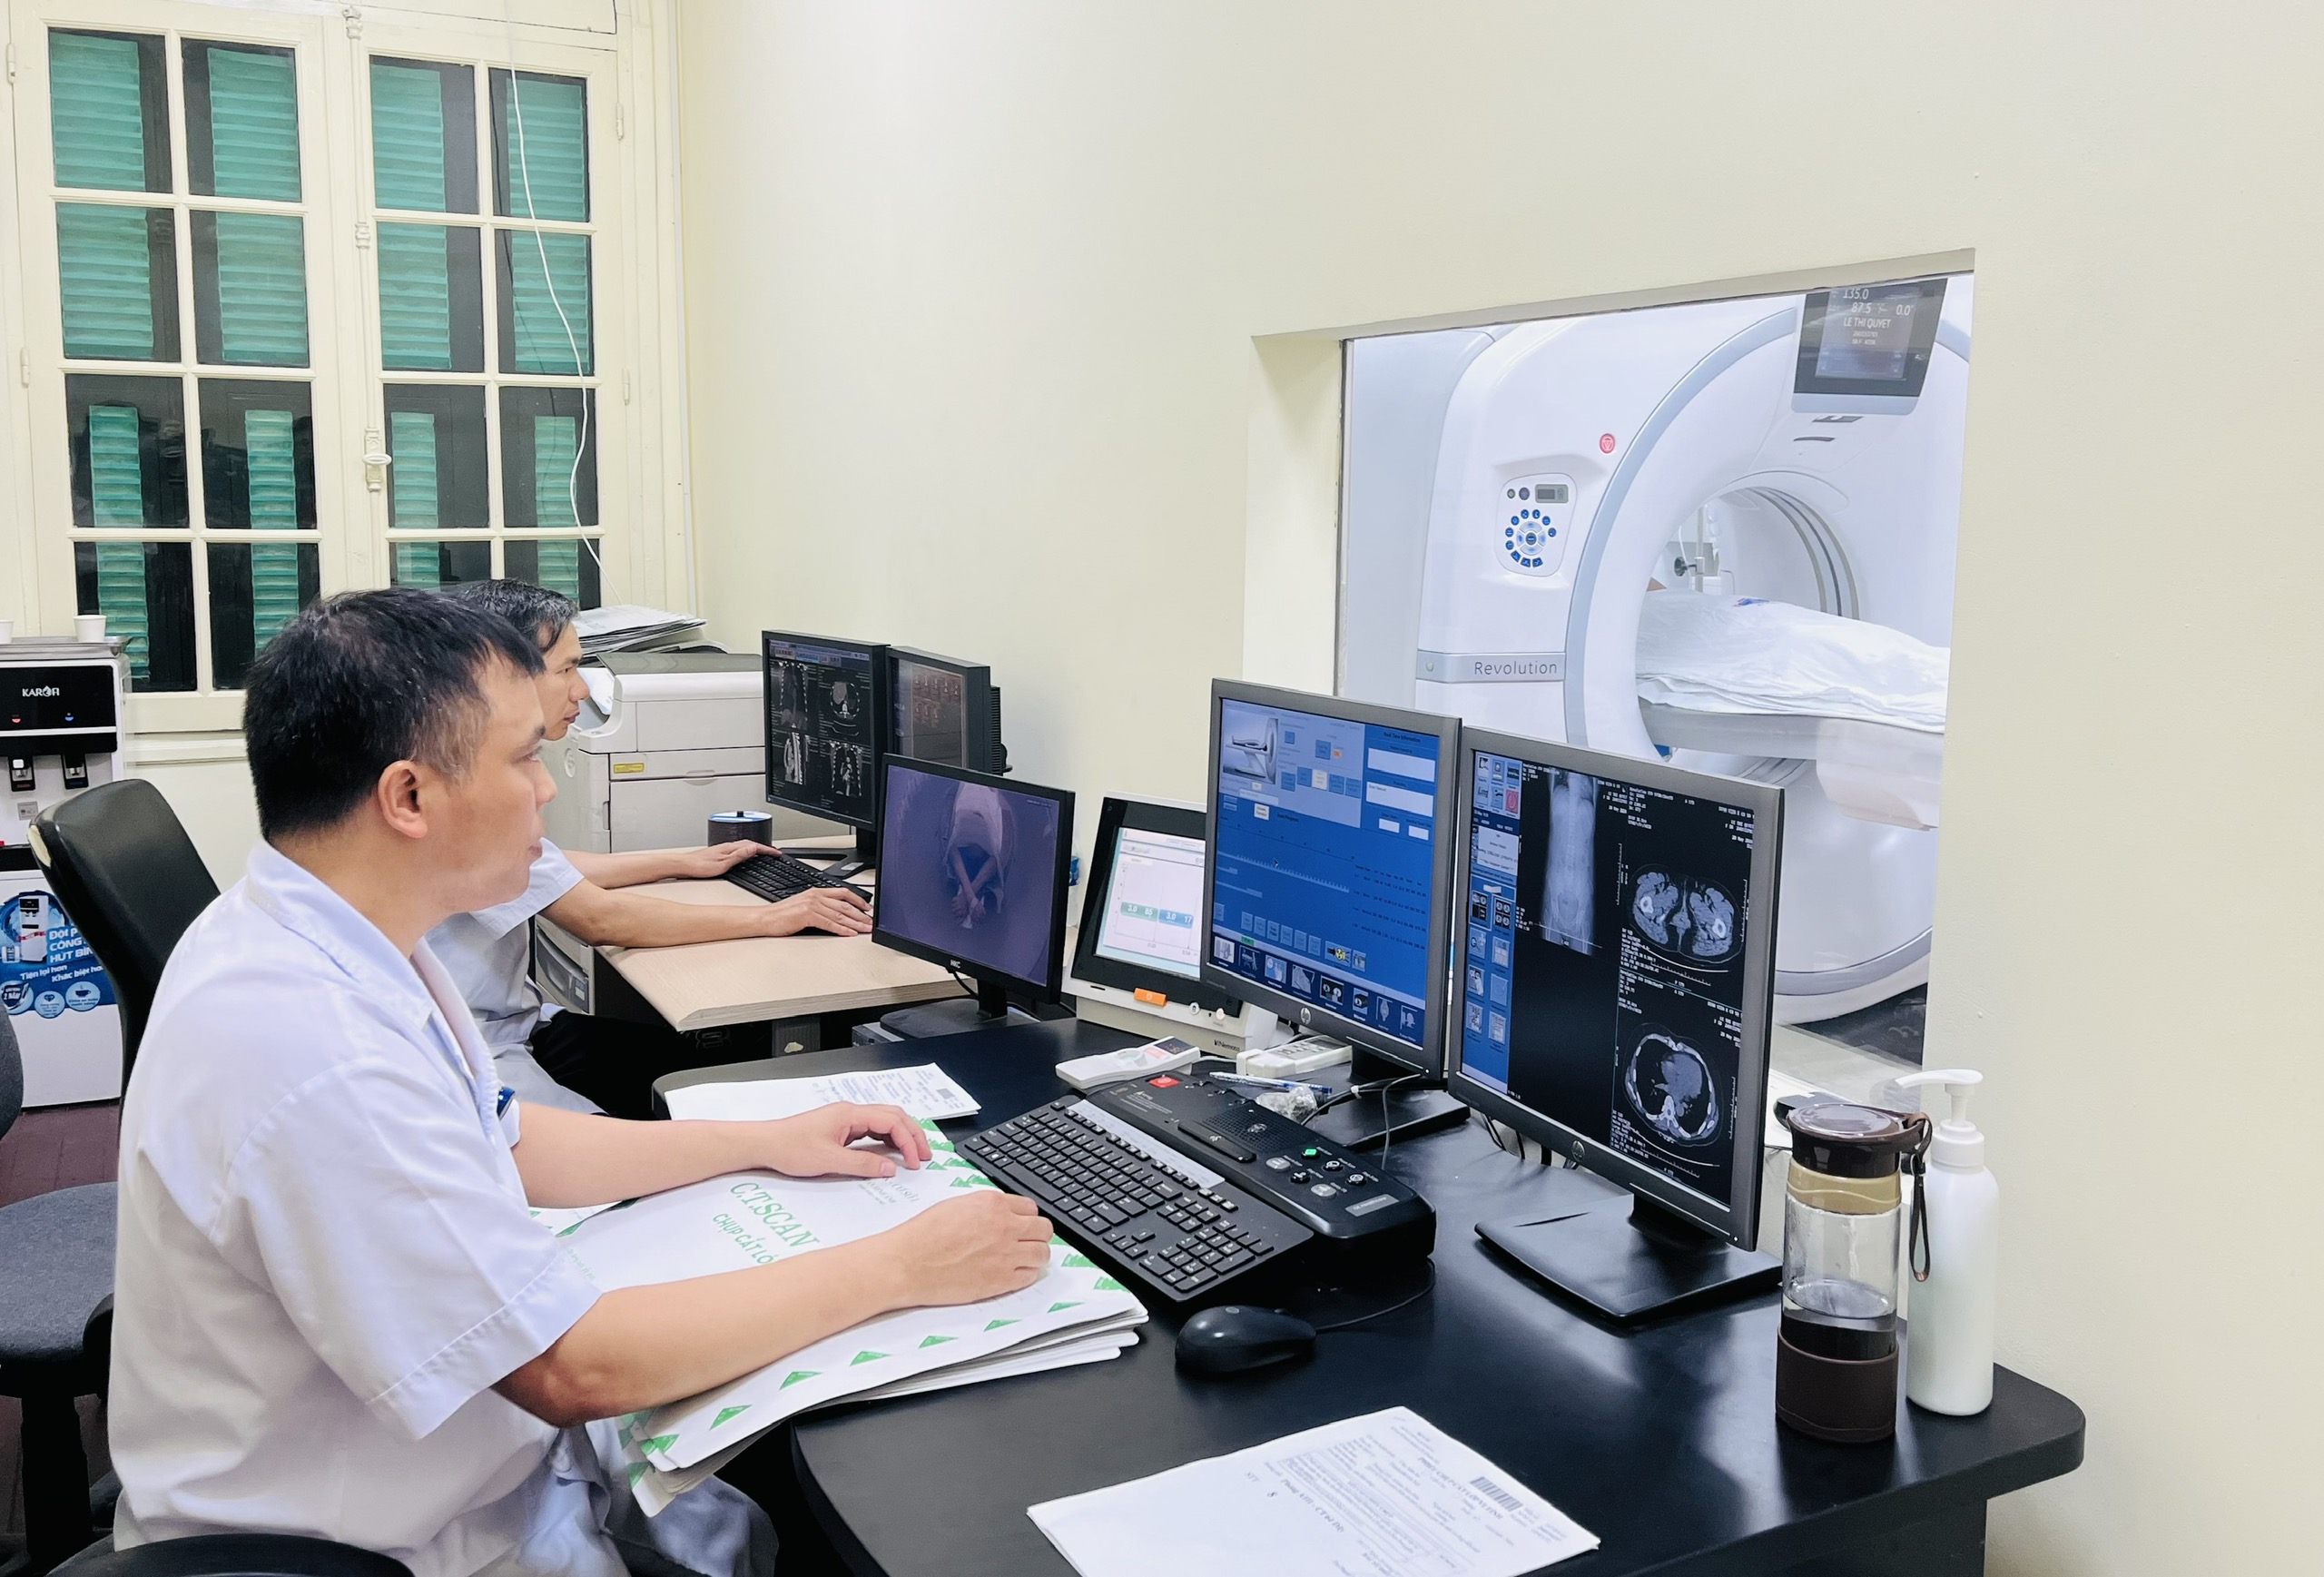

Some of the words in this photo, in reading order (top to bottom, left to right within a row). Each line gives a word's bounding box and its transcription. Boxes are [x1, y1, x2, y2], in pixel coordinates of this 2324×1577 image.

[1473, 660, 1557, 675] Revolution
[1127, 904, 1137, 913] 3.0
[1144, 908, 1153, 916] 85
[1166, 912, 1177, 921] 3.0
[1184, 915, 1192, 924] 17
[712, 1213, 744, 1235] CHỤP
